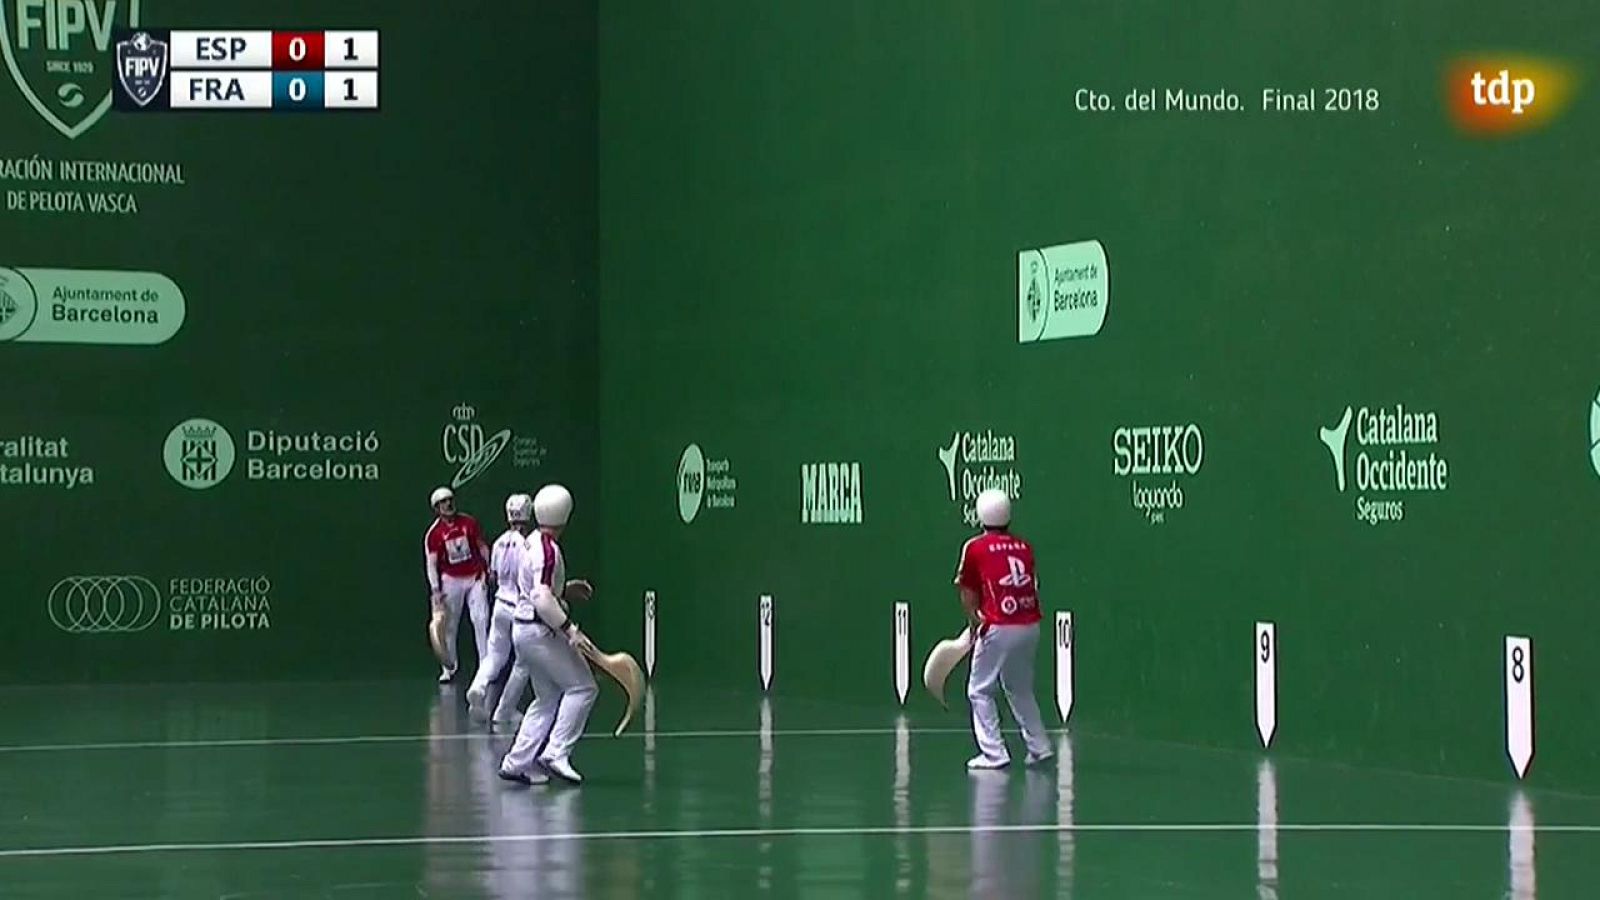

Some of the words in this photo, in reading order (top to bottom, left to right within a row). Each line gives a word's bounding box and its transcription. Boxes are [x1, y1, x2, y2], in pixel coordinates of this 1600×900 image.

[16, 0, 117, 51] FIPV
[60, 160, 186, 185] INTERNACIONAL
[7, 190, 27, 211] DE
[29, 191, 85, 213] PELOTA
[87, 193, 138, 214] VASCA
[52, 286, 137, 303] Ajuntament
[140, 288, 159, 302] de
[52, 303, 159, 324] Barcelona
[1357, 405, 1438, 446] Catalana
[247, 429, 380, 456] Diputació
[443, 423, 486, 464] CSD
[962, 429, 1016, 464] Catalana
[1113, 423, 1204, 476] SEIKO
[247, 459, 380, 481] Barcelona
[1356, 450, 1448, 491] Occidente
[801, 461, 863, 524] MARCA
[1357, 496, 1404, 526] Seguros
[169, 575, 271, 595] FEDERACIÓ
[169, 594, 271, 612] CATALANA
[169, 612, 195, 630] DE
[200, 612, 270, 630] PILOTA
[898, 608, 908, 637] 11
[1058, 618, 1072, 650] 10
[1260, 629, 1271, 664] 9
[1511, 645, 1525, 684] 8
